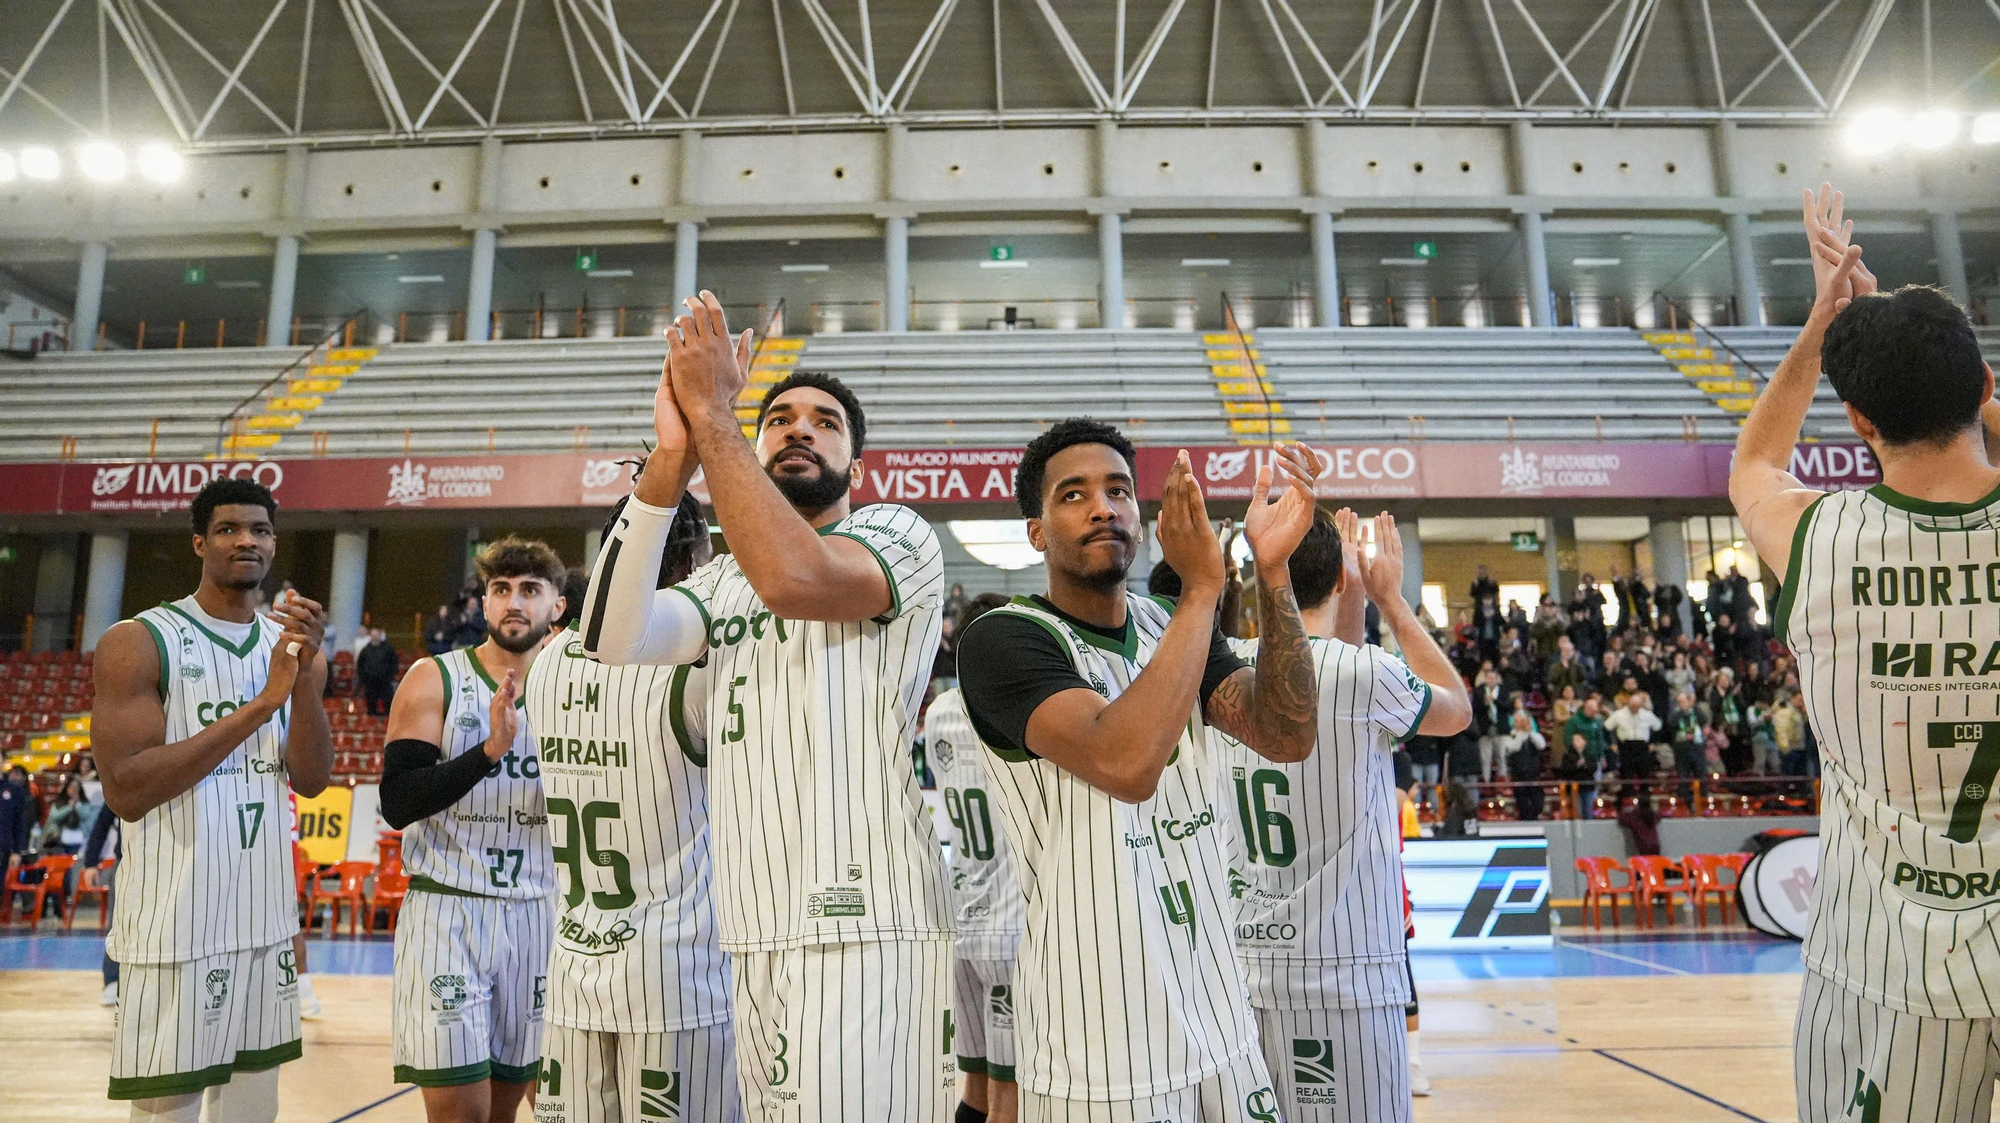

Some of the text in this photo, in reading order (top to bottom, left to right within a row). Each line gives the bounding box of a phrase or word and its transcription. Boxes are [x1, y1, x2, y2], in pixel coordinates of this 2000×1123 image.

[581, 256, 591, 269] 2
[885, 452, 949, 467] PALACIO
[1541, 454, 1621, 470] AYUNTAMIENTO
[1789, 446, 1878, 478] MDE
[429, 465, 505, 481] AYUNTAMIENTO
[1541, 470, 1555, 486] DE
[427, 481, 440, 498] DE
[869, 468, 971, 500] VISTA
[1321, 486, 1369, 498] Deportes
[1851, 561, 2000, 607] RODRIG
[1943, 640, 2000, 678] RA
[1870, 680, 2000, 692] SOLUCIONES INTEGRA
[561, 681, 600, 713] J-M
[1954, 724, 1983, 740] CCB
[567, 738, 628, 768] RAHI
[568, 768, 603, 778] INTEGRALES
[1926, 720, 2000, 844] 7
[236, 802, 265, 850] 17
[453, 810, 548, 829] Fundación Cajas
[944, 786, 995, 861] 90
[1233, 766, 1297, 868] 16
[486, 847, 525, 888] 27
[1158, 879, 1197, 951] 4
[1296, 1087, 1336, 1097] REALE
[1296, 1096, 1337, 1105] SEGUROS
